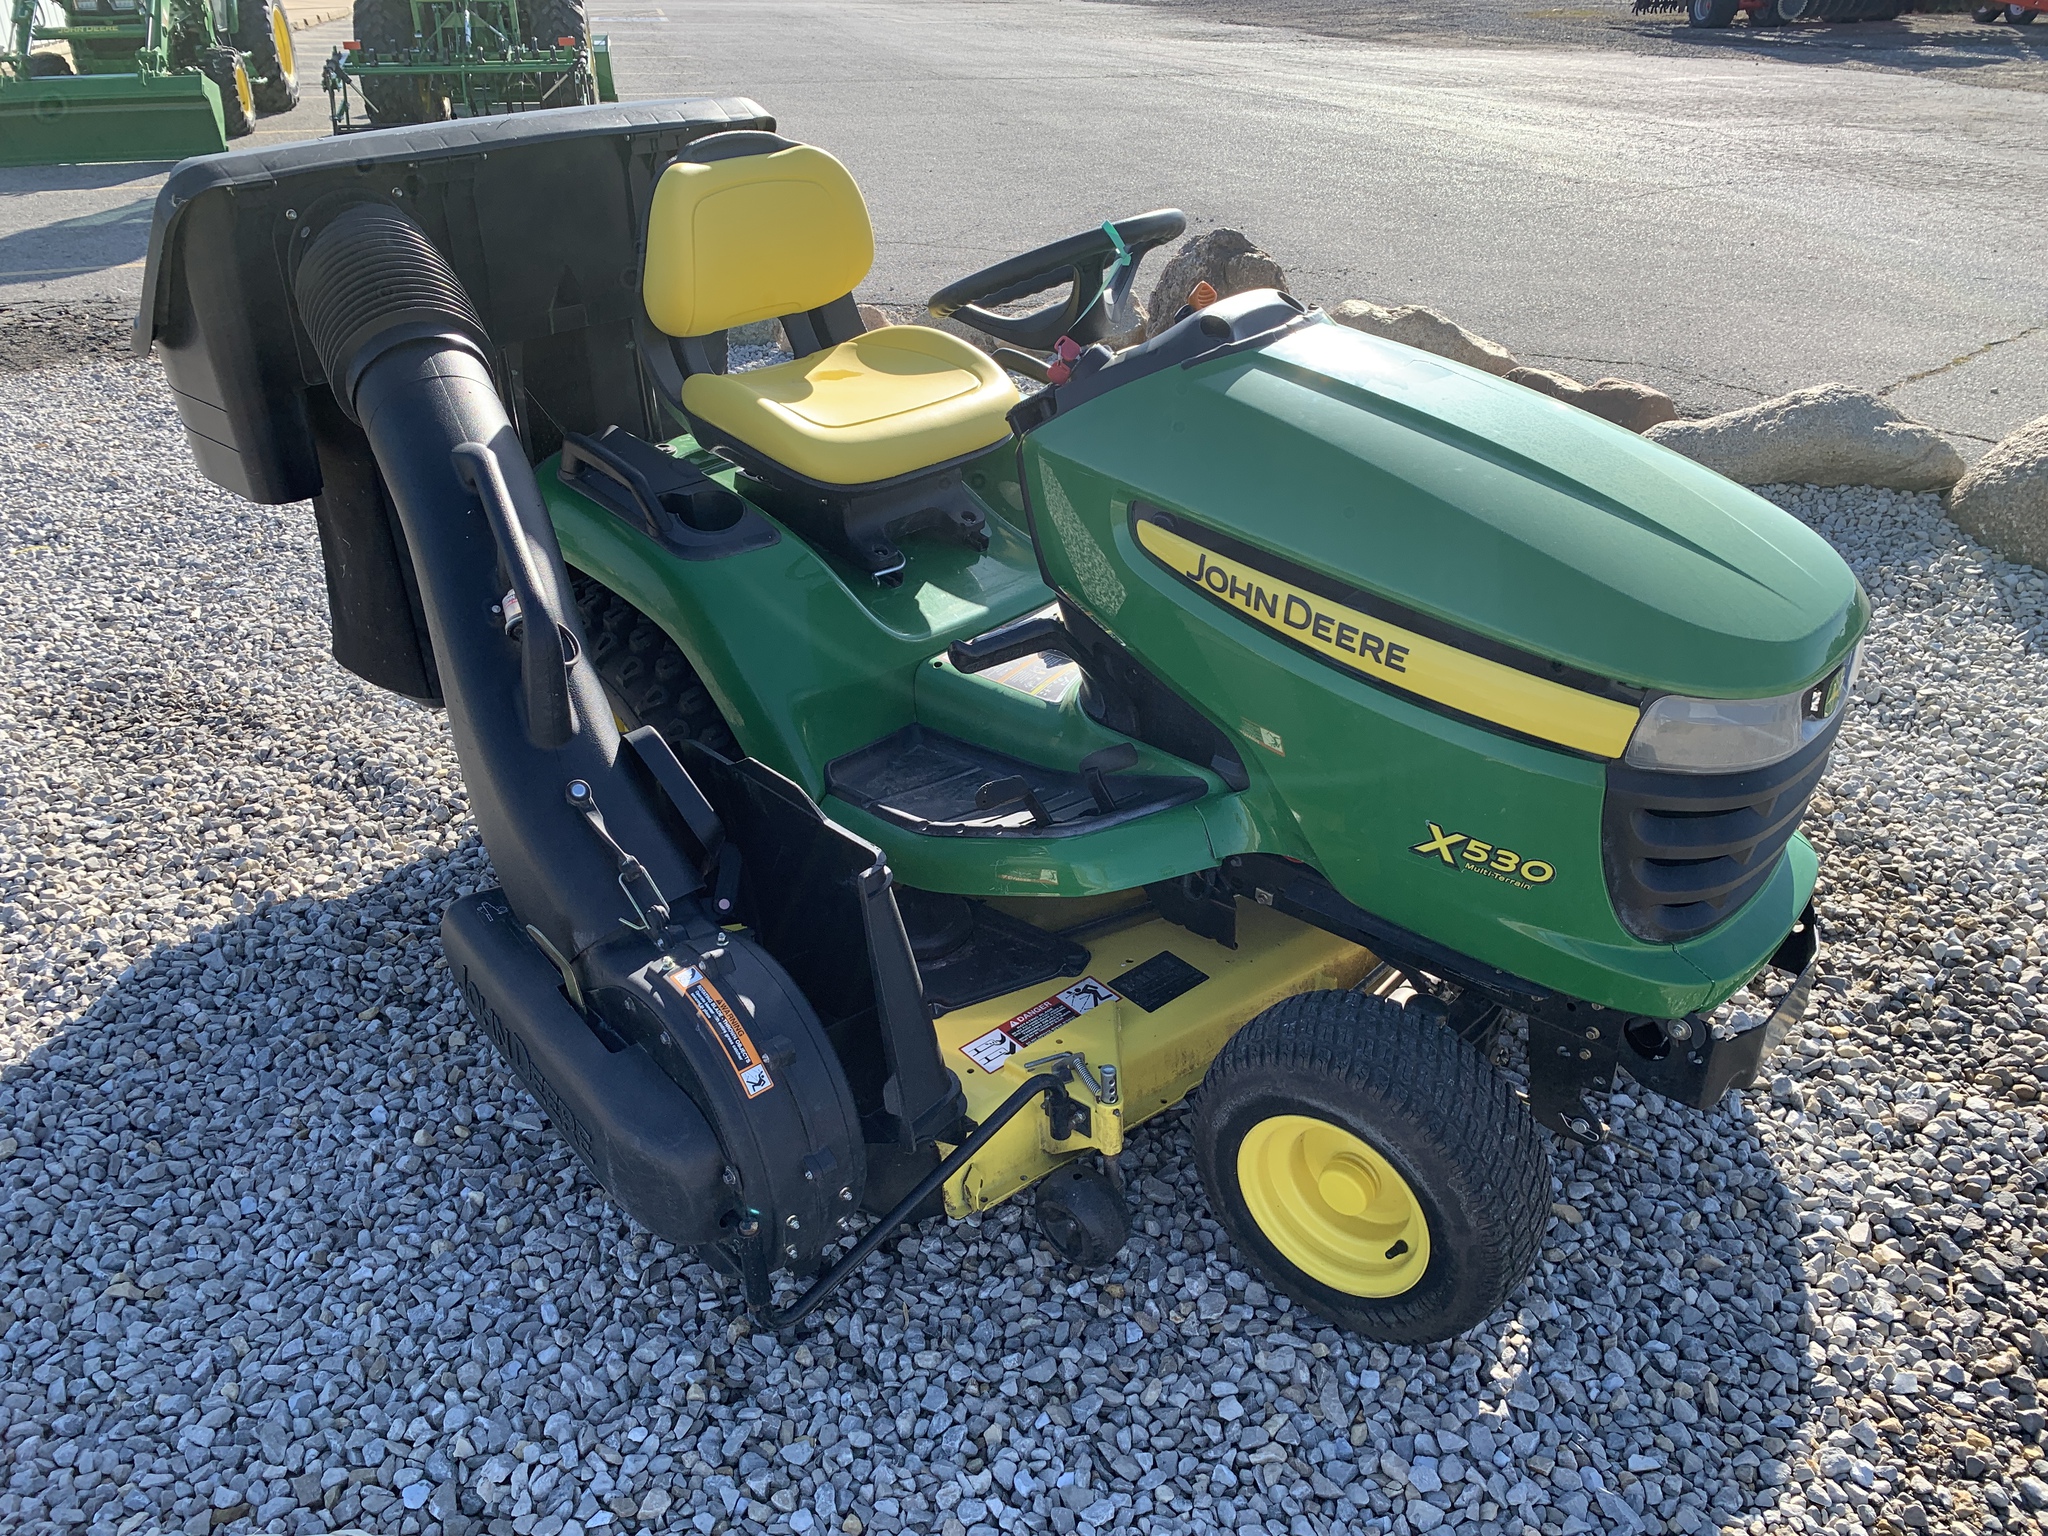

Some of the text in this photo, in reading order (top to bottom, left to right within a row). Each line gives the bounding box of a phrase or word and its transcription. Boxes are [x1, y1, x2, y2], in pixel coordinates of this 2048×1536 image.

[58, 26, 84, 34] JOHN
[1186, 553, 1410, 673] JOHN DEERE
[1408, 820, 1556, 885] X530
[1464, 862, 1531, 891] Multi-Terrain
[720, 1003, 744, 1037] WARNING
[1016, 1001, 1052, 1023] DANGER
[710, 1001, 723, 1018] BLADE
[721, 1018, 737, 1040] THROWN
[735, 1039, 751, 1063] OBJECTS
